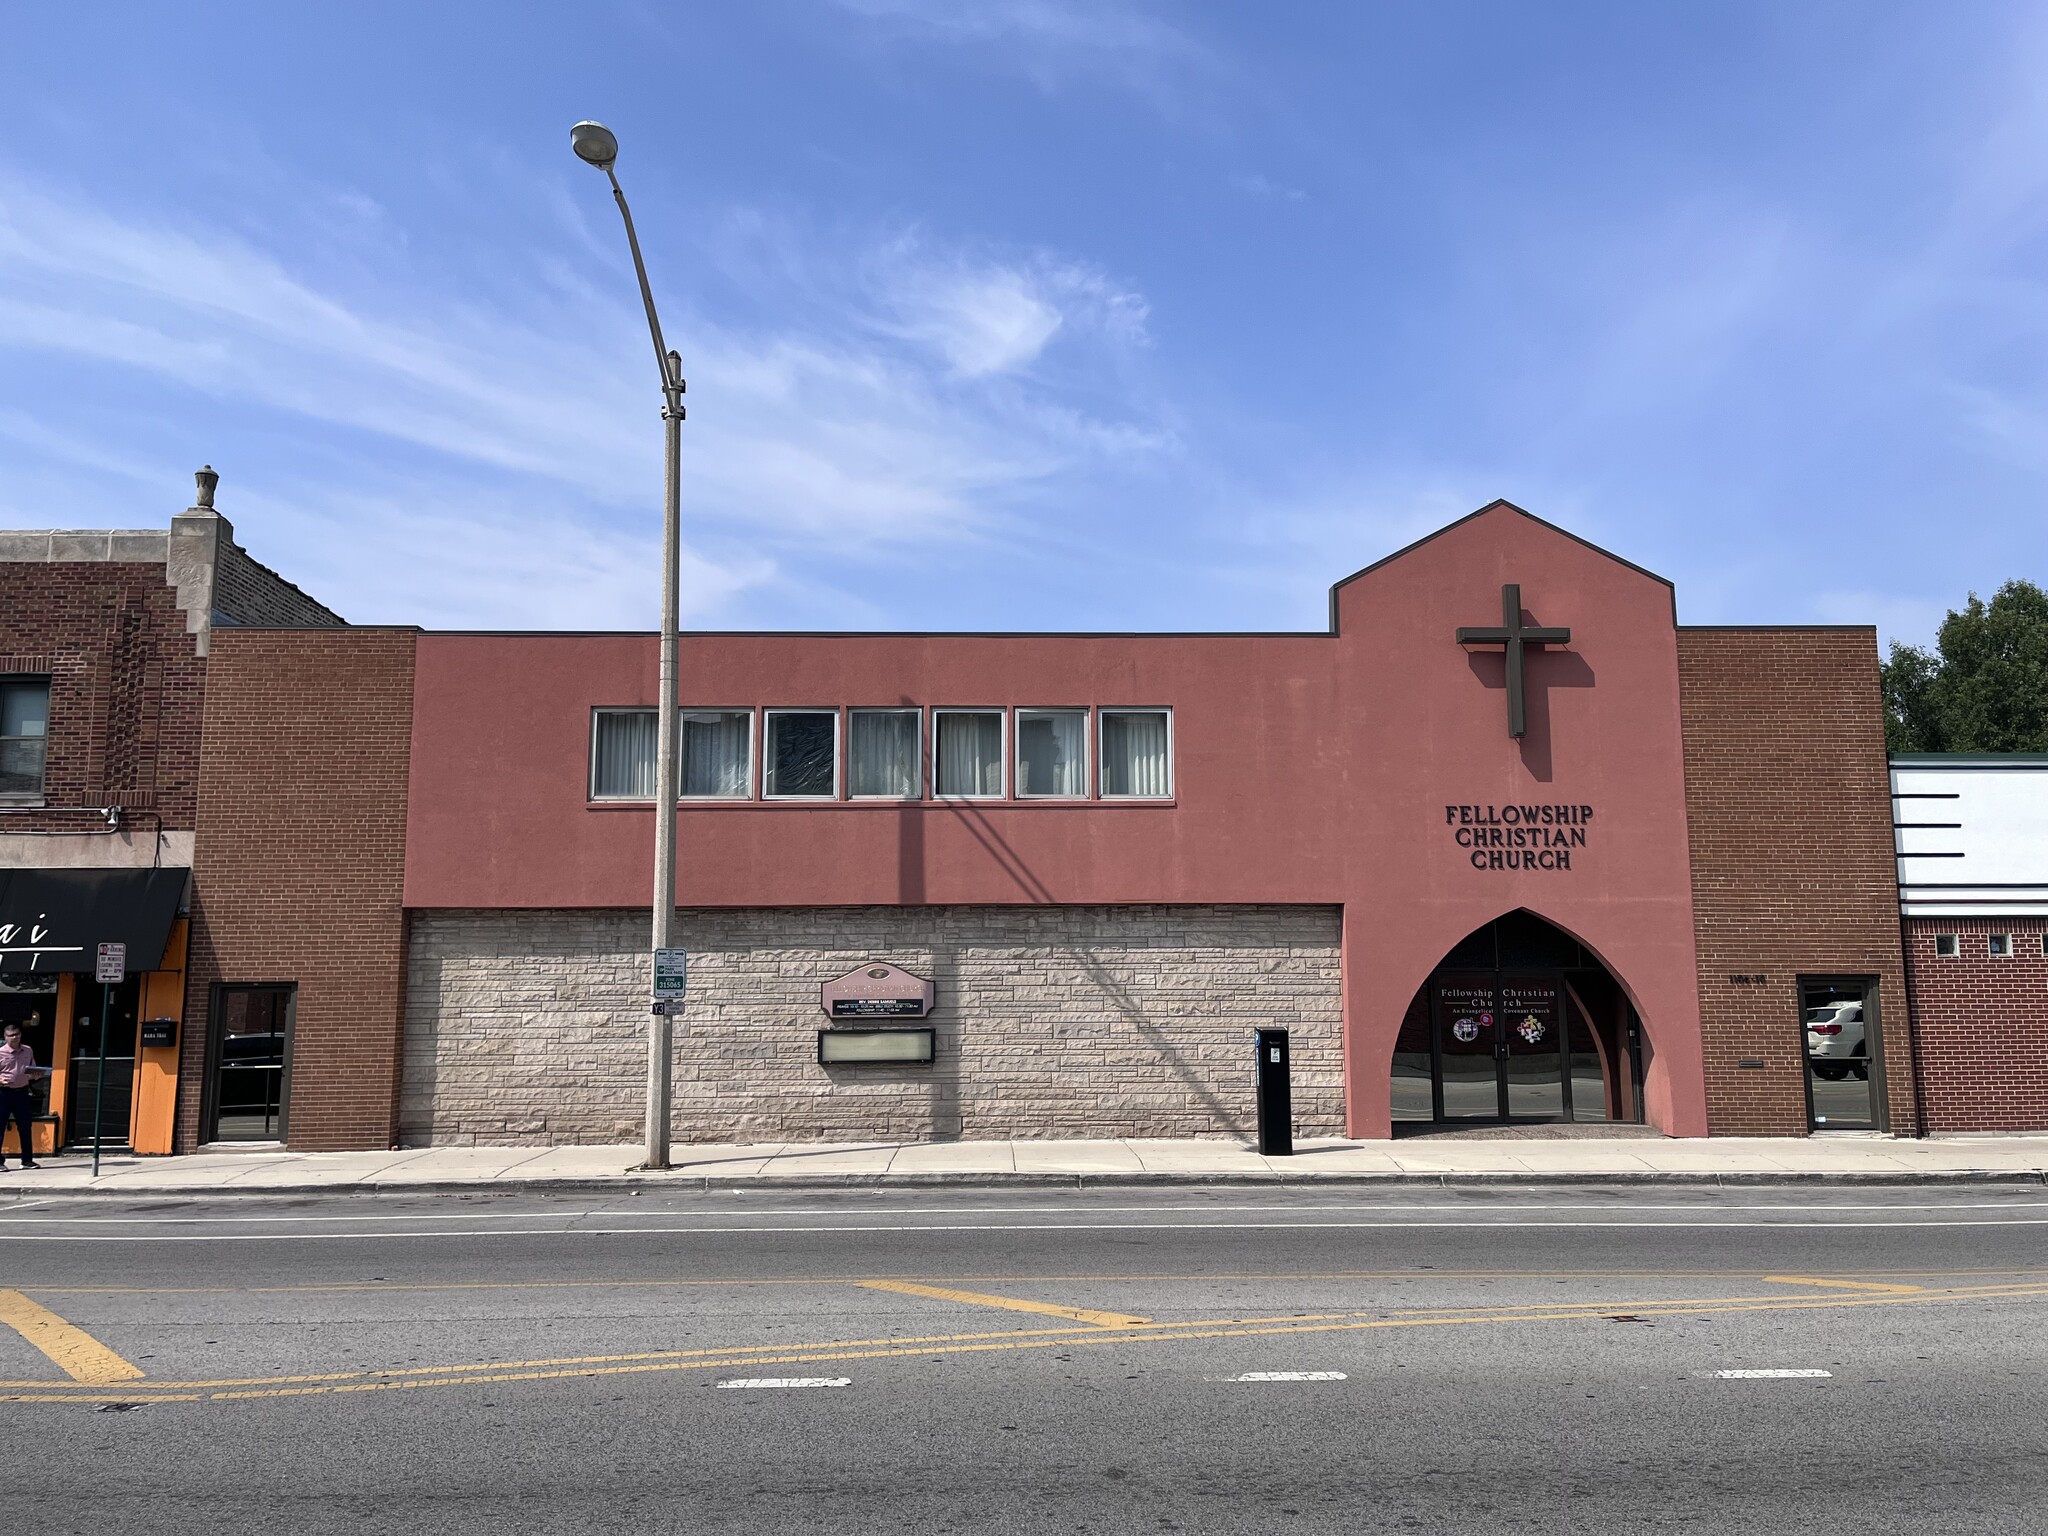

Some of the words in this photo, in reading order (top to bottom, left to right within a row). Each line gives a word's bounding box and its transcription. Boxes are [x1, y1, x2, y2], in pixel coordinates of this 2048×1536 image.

[1445, 805, 1594, 825] FELLOWSHIP
[1455, 827, 1586, 847] CHRISTIAN
[1470, 850, 1571, 870] CHURCH
[1441, 989, 1493, 998] Fellowship
[1502, 989, 1555, 997] Christian
[654, 1004, 664, 1014] Y3
